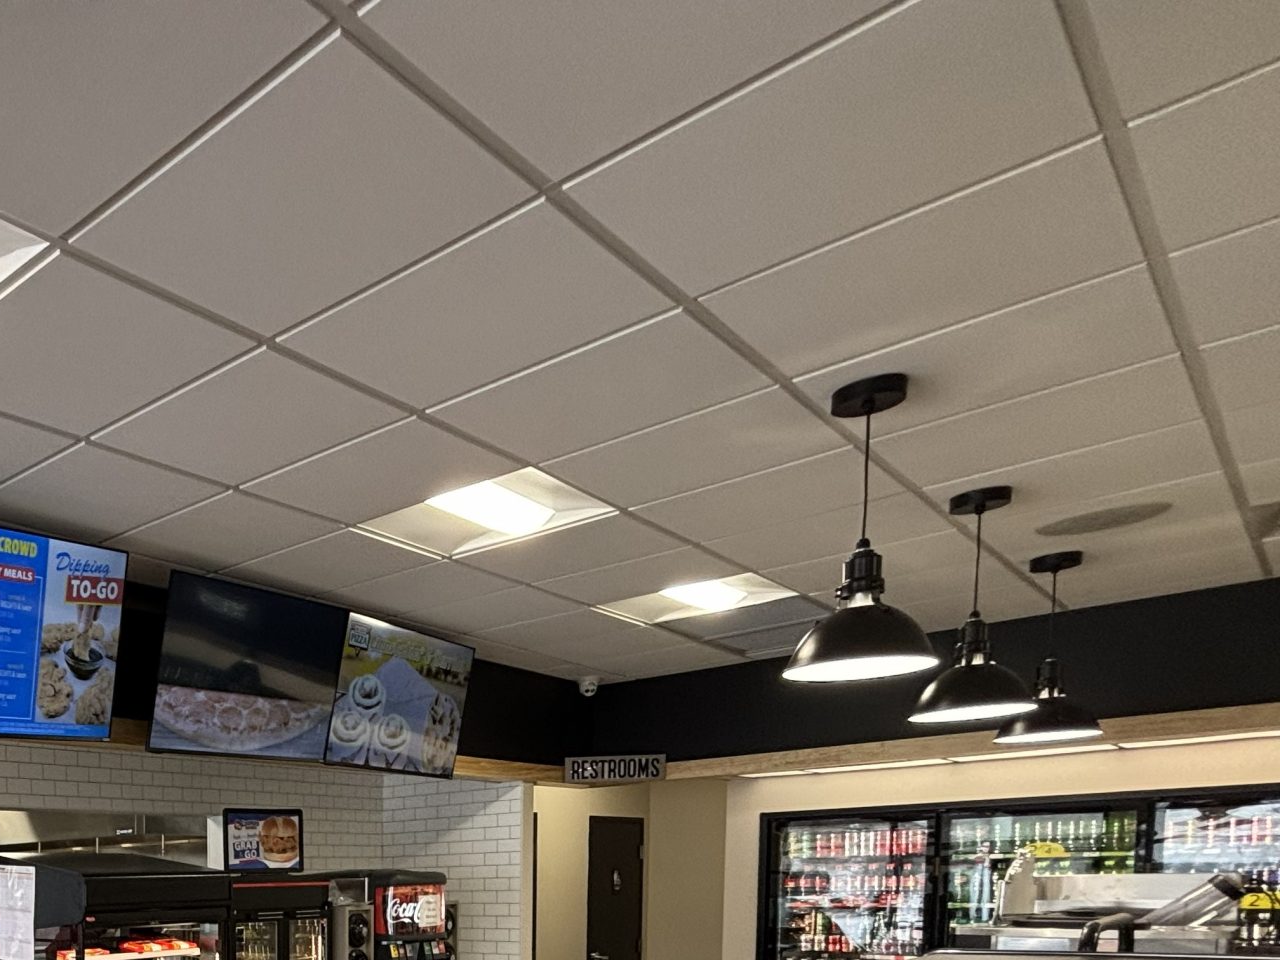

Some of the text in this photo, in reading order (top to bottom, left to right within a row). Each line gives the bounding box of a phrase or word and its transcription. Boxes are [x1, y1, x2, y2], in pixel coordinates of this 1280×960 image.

[56, 552, 111, 577] Dipping
[3, 567, 33, 581] MEALS
[71, 579, 119, 600] TO-GO
[571, 758, 660, 779] RESTROOMS
[234, 840, 258, 851] GRAB
[244, 849, 257, 859] GO
